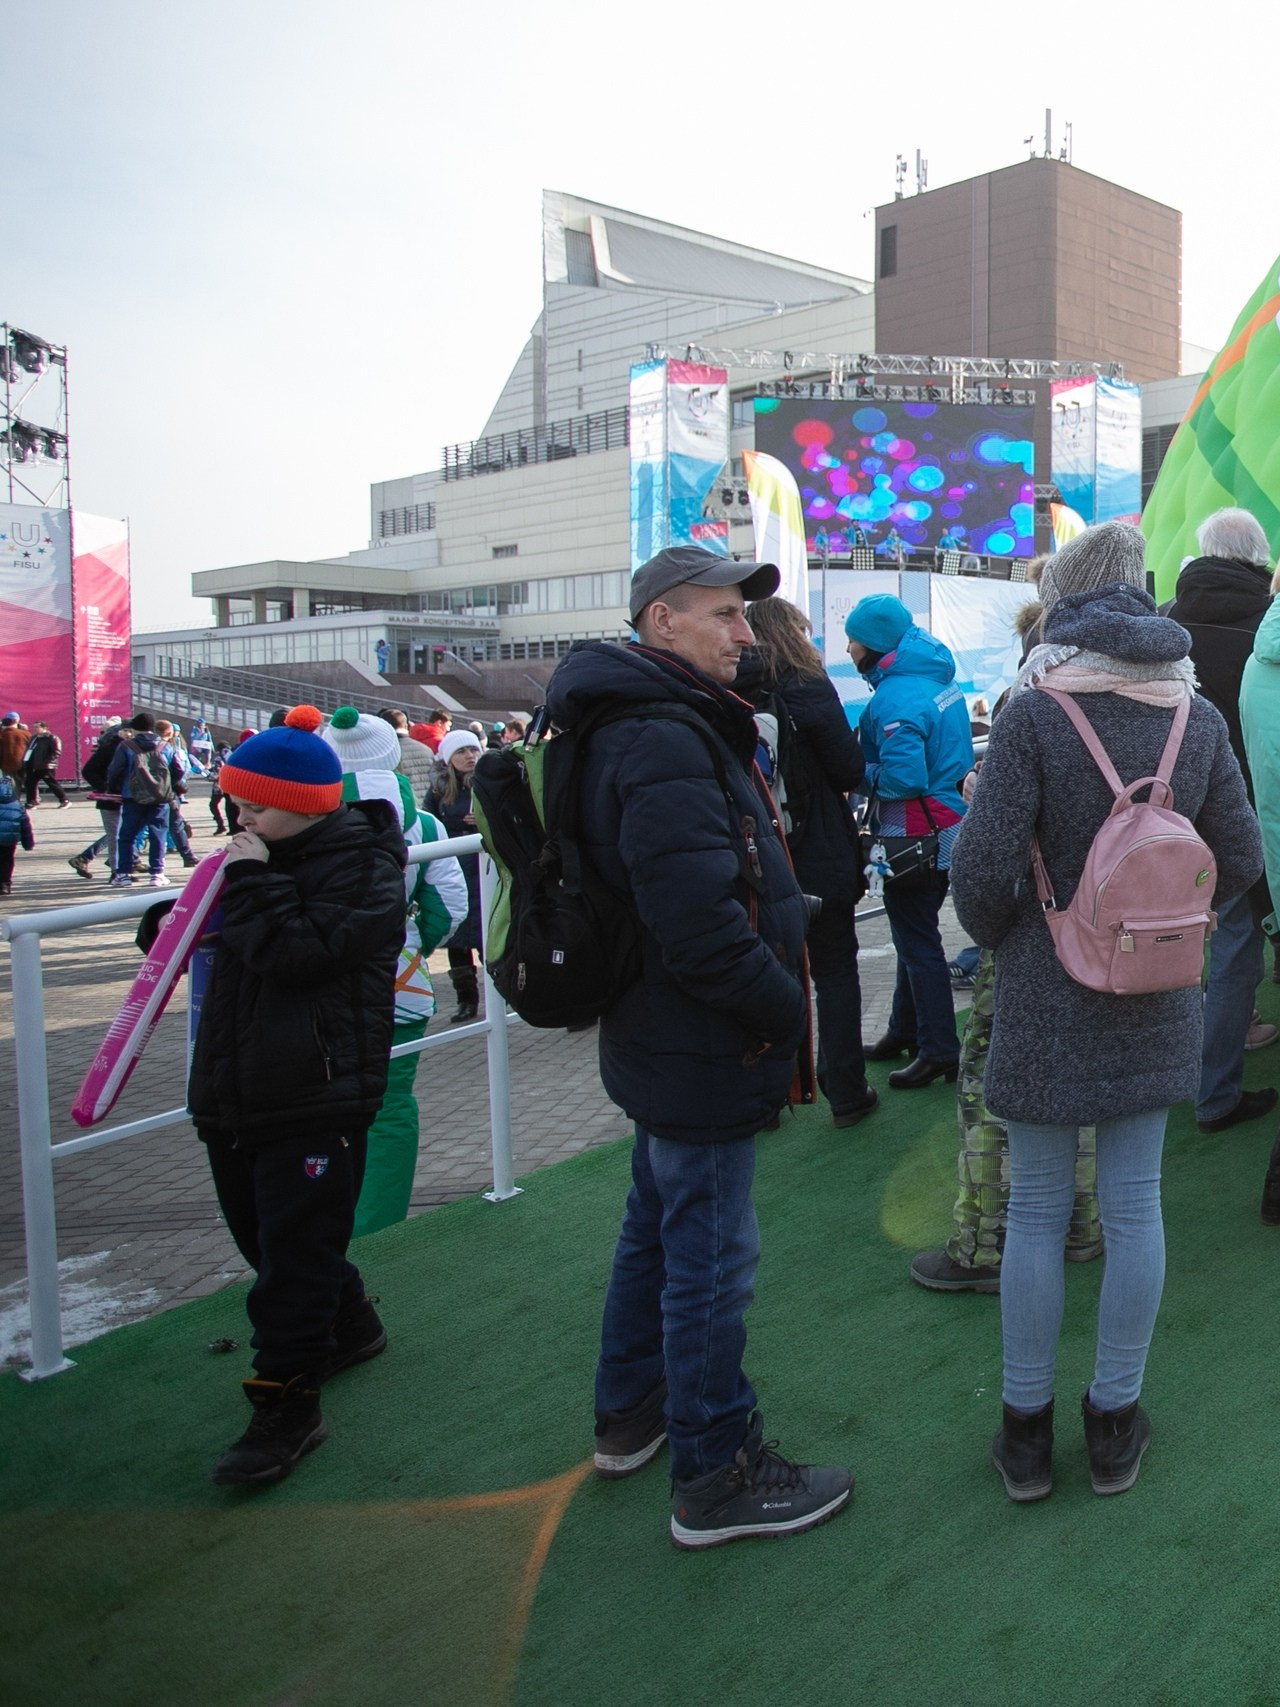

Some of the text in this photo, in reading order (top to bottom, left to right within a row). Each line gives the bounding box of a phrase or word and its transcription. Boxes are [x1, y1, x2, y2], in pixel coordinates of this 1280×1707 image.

[13, 560, 41, 569] FISU
[388, 615, 420, 624] МАЛЫЙ
[423, 617, 475, 626] КОНЦЕРТНЫЙ
[768, 1501, 791, 1509] Columbia
